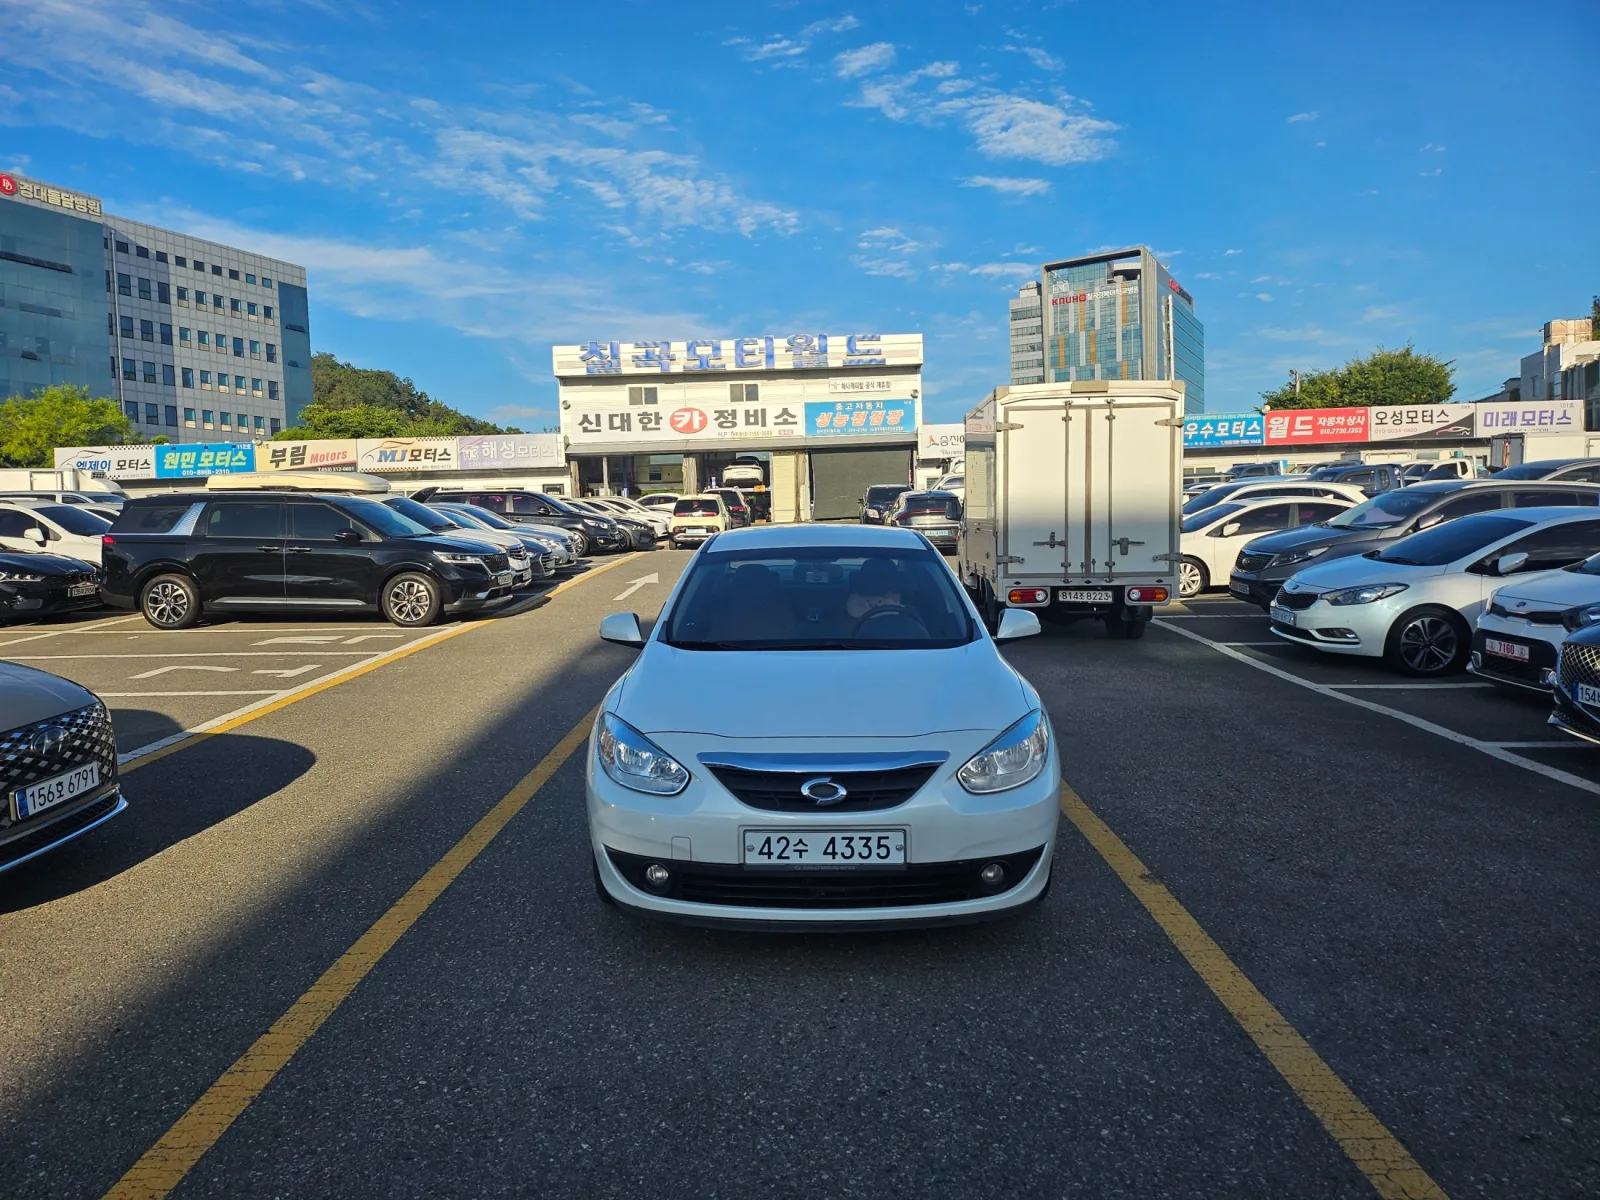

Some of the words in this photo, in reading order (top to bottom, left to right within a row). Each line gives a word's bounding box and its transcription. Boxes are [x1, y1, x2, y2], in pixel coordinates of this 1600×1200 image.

[578, 411, 663, 433] 신대한
[713, 407, 798, 429] 정비소
[1317, 416, 1345, 427] 자동차
[1346, 416, 1366, 426] 상사
[1375, 409, 1450, 426] 오성모터스
[1268, 416, 1314, 439] 월드
[270, 444, 308, 468] 부림
[309, 450, 348, 464] Motors
[377, 449, 408, 462] MJ
[408, 447, 452, 462] 모터스
[481, 441, 516, 459] 해성
[115, 459, 151, 471] 모터스
[163, 452, 197, 469] 원민
[198, 450, 247, 467] 모터스
[1086, 591, 1109, 601] 8223
[1498, 642, 1515, 655] 7160
[67, 766, 96, 794] 6791
[758, 836, 809, 860] 42수
[822, 836, 891, 860] 4335
